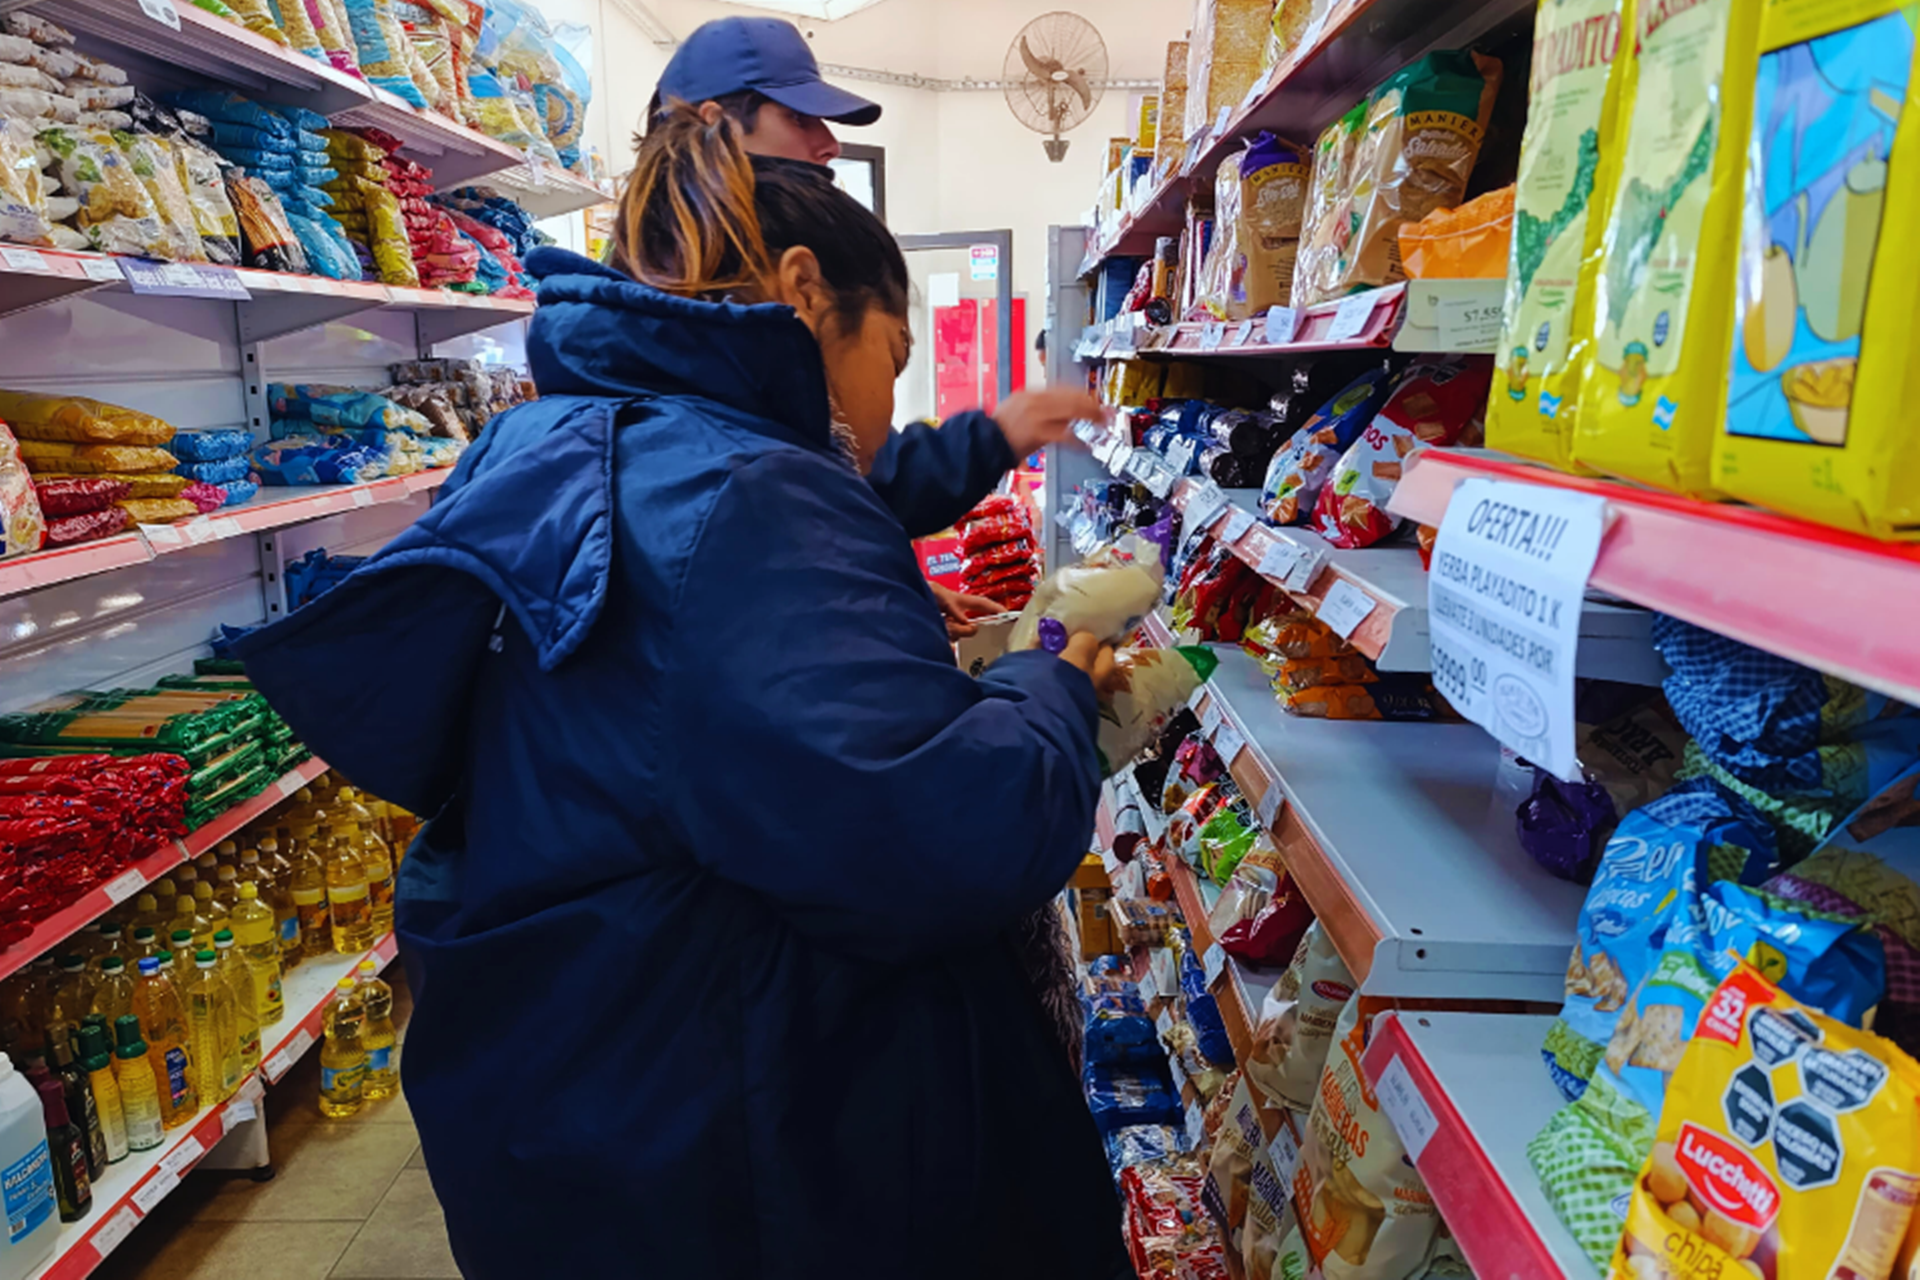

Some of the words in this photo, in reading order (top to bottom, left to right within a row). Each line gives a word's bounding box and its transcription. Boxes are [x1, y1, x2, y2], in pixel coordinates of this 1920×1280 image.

[1467, 499, 1569, 562] OFERTA!!!
[1437, 552, 1468, 587] YERBA
[1469, 564, 1538, 618] PLAYADITO
[1474, 612, 1527, 661] UNIDADES
[1527, 640, 1555, 675] POR
[1710, 987, 1745, 1030] 32
[1682, 1132, 1775, 1214] Lucchetti
